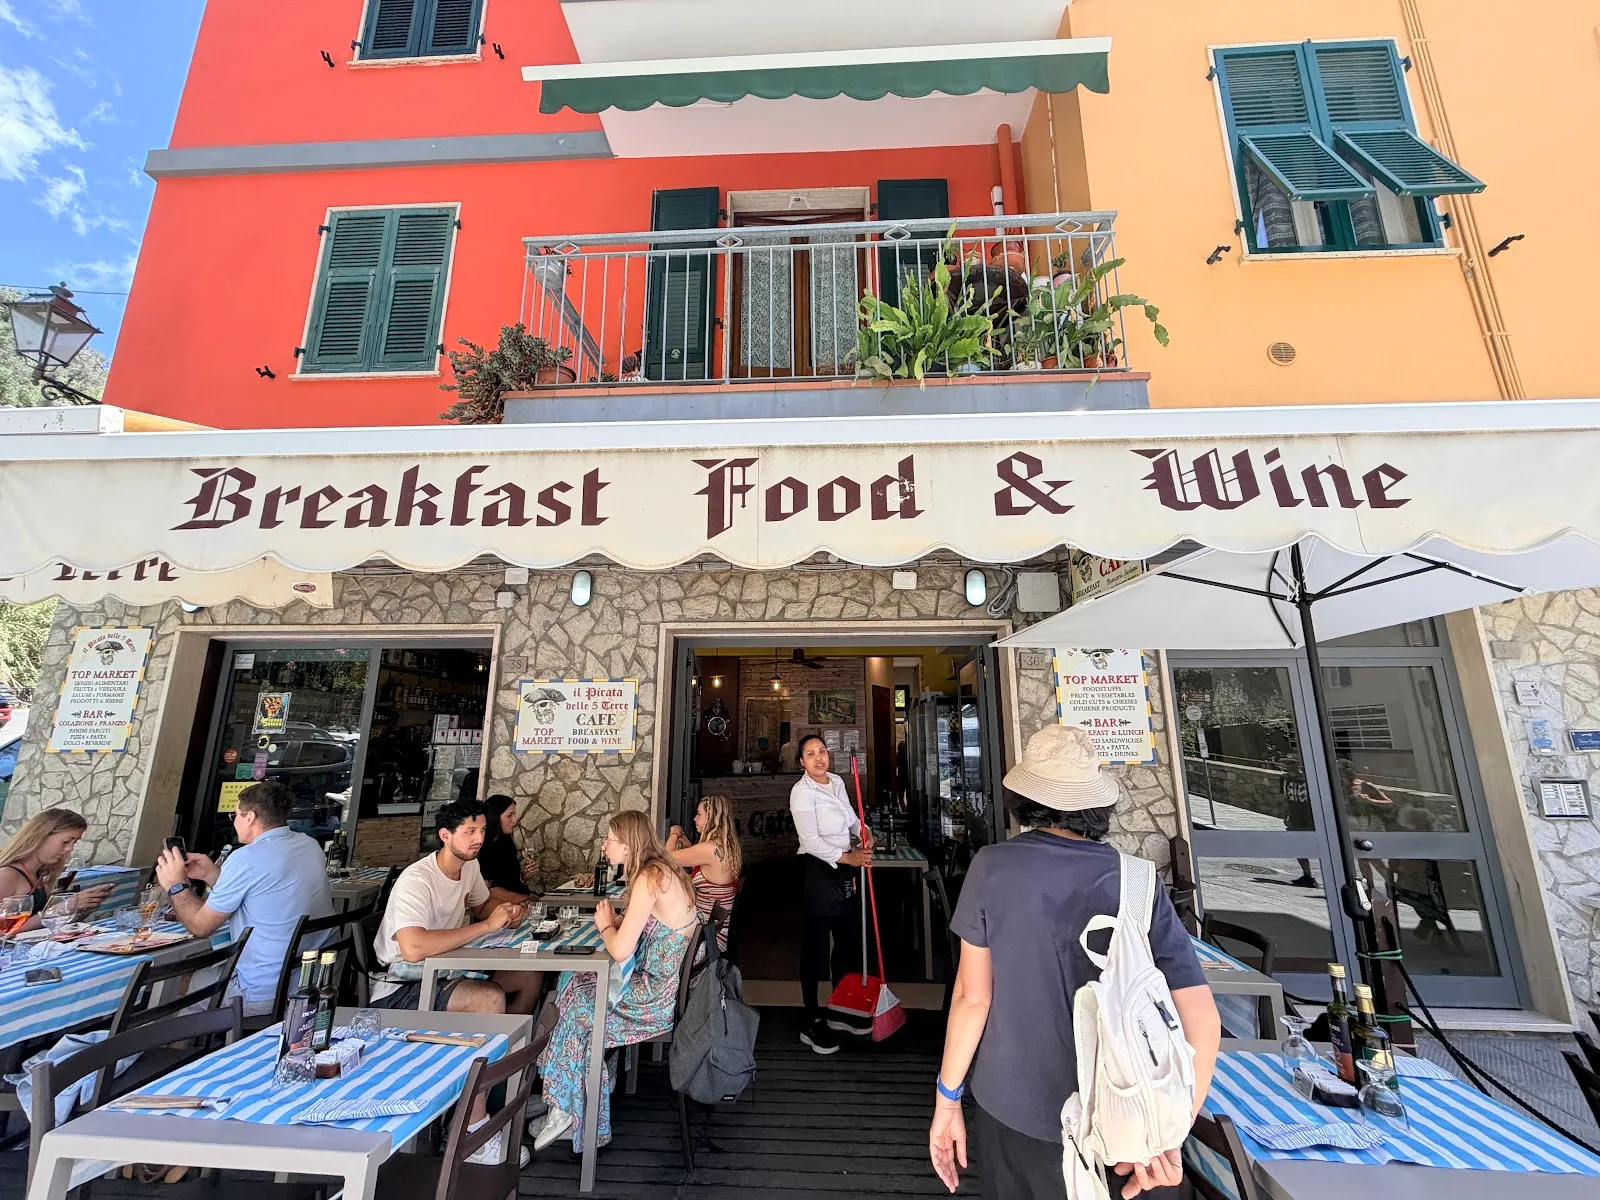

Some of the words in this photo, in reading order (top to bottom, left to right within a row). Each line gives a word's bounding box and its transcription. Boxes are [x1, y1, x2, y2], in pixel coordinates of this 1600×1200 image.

[169, 464, 611, 530] Breakfast
[691, 454, 925, 540] Food
[994, 451, 1076, 516] &
[1129, 447, 1412, 511] Wine
[508, 659, 522, 670] 38
[72, 671, 94, 679] TOP
[93, 670, 137, 679] MARKET
[1063, 675, 1087, 685] TOP
[1090, 674, 1139, 685] MARKET
[573, 688, 581, 698] il
[585, 686, 623, 700] Pirata
[565, 701, 589, 711] delle
[591, 701, 599, 710] 5
[601, 701, 629, 711] Terre
[82, 710, 103, 719] BAR
[575, 713, 617, 726] CAFE
[1094, 719, 1118, 728] BAR
[533, 728, 555, 736] TOP
[572, 728, 620, 736] BREAKFAST
[522, 737, 564, 745] MARKET
[567, 737, 590, 745] FOOD
[601, 737, 622, 745] WINE
